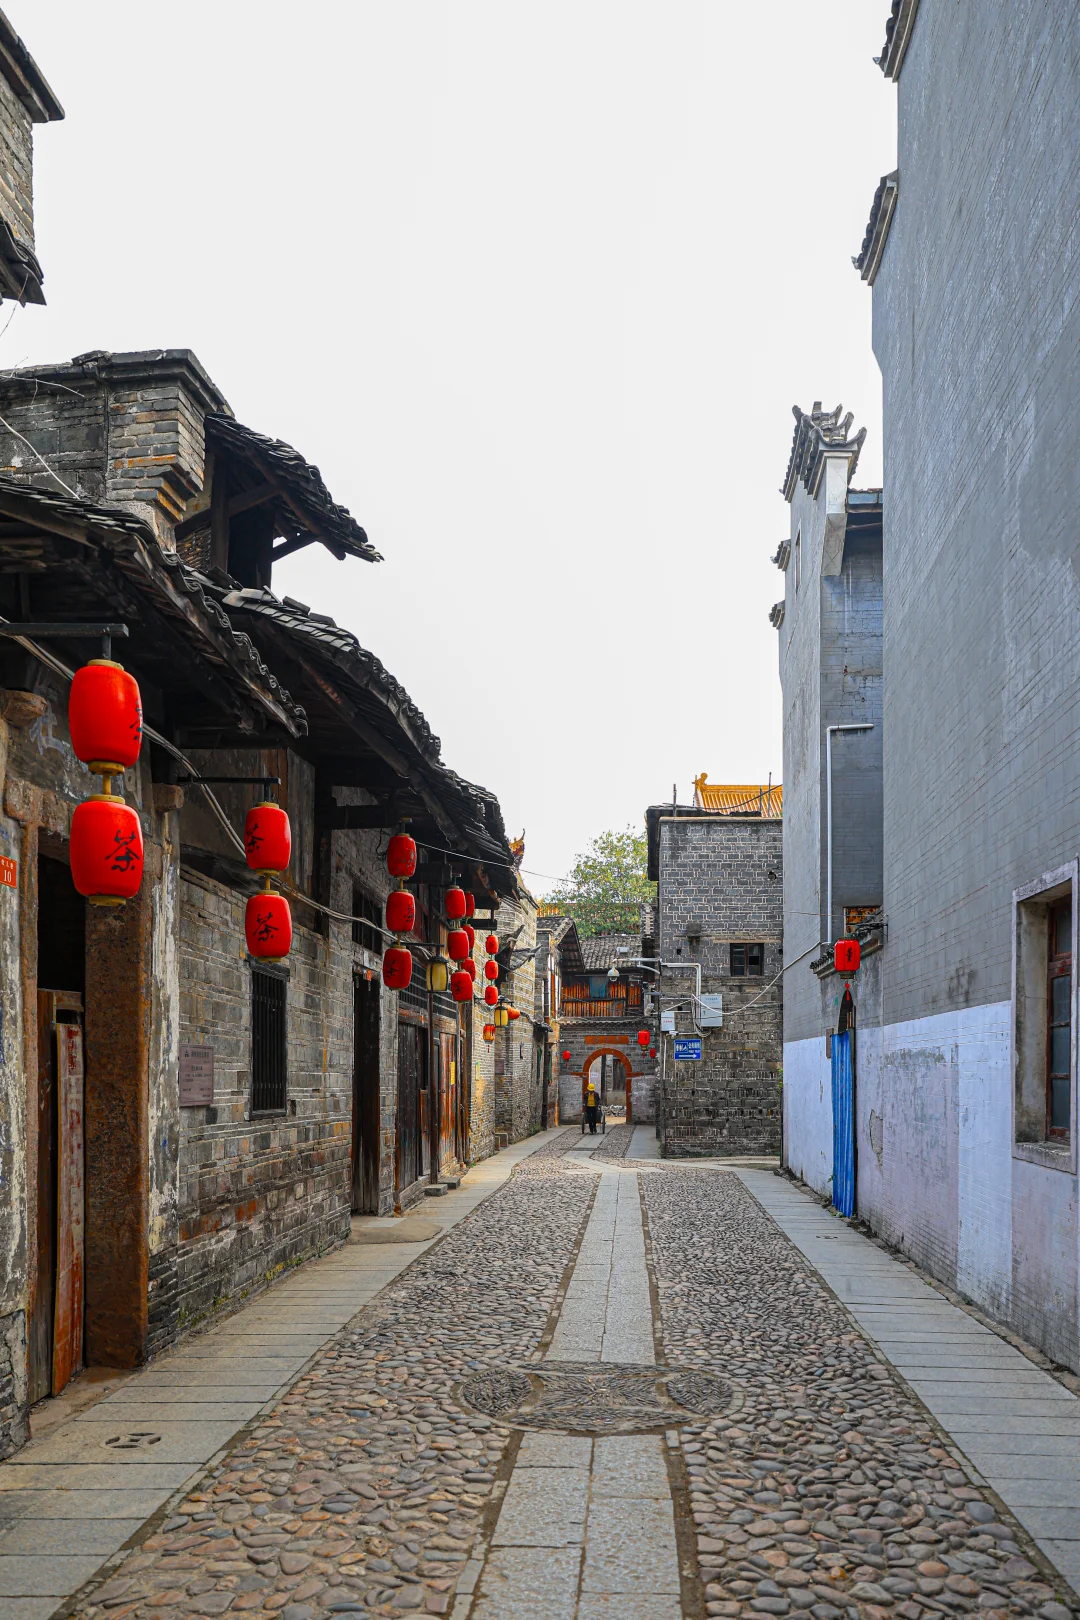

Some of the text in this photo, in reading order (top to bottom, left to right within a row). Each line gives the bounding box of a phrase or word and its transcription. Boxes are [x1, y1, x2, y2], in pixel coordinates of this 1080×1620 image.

[105, 829, 140, 872] 茶
[4, 869, 12, 883] 10
[253, 912, 279, 942] 茶
